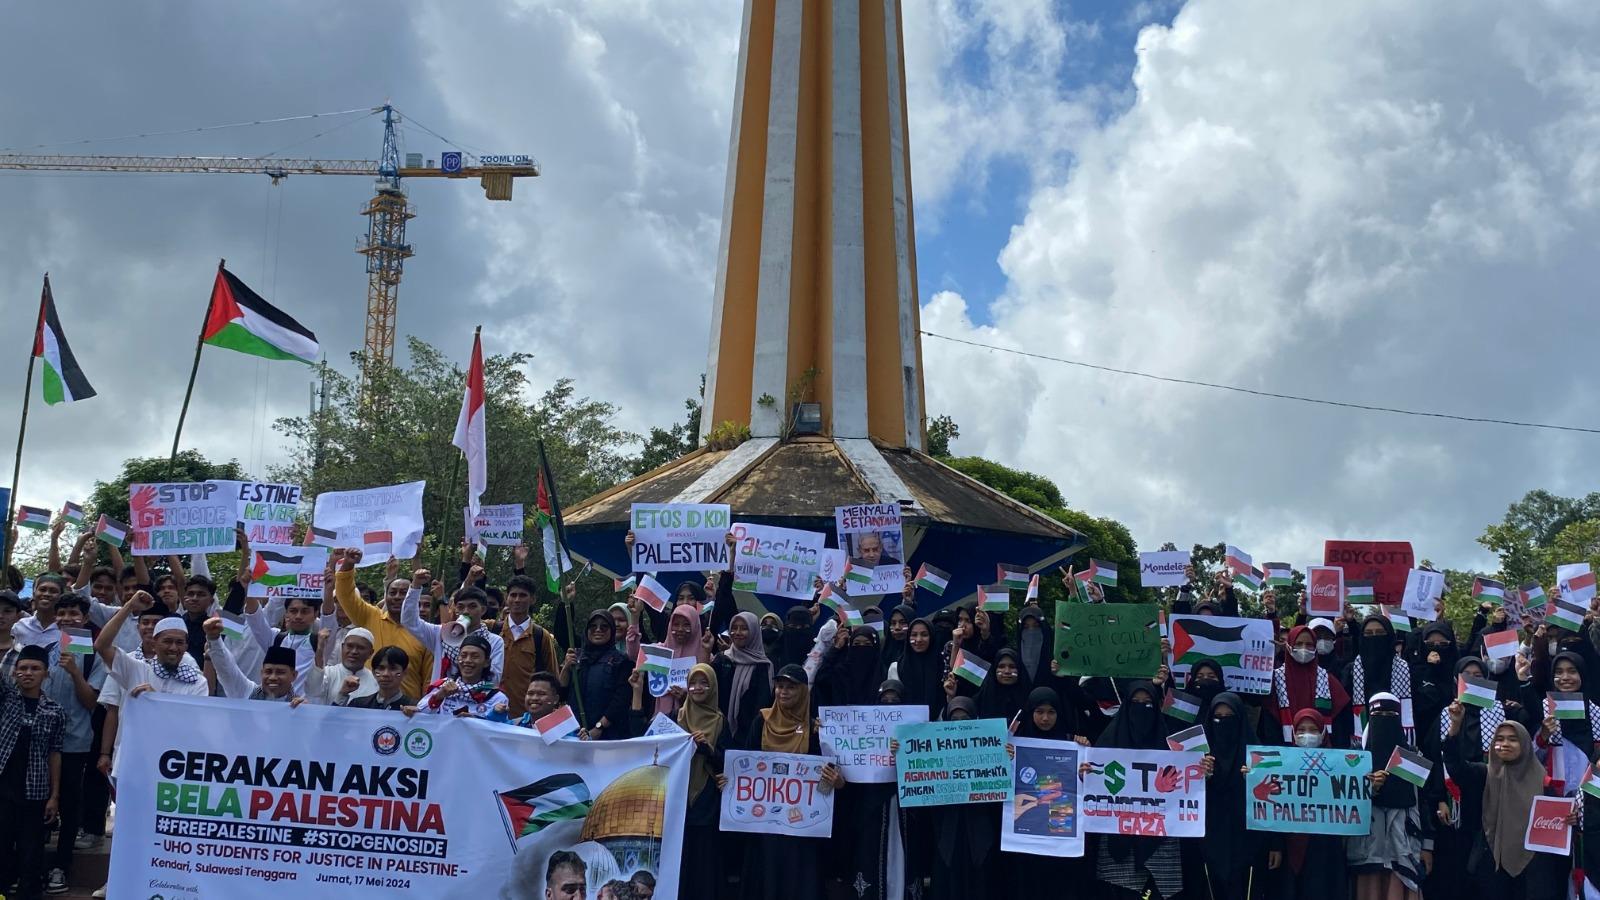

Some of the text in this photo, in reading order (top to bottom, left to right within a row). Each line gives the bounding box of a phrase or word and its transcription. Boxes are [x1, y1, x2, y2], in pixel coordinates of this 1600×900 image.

[480, 155, 529, 164] ZOOMLION
[159, 484, 218, 502] STOP
[238, 484, 299, 505] ESTINE
[138, 506, 228, 528] GENOCIDE
[244, 503, 296, 521] NEVER
[635, 509, 682, 529] ETOS
[704, 509, 728, 529] KDI
[842, 505, 894, 517] MENYALA
[134, 526, 235, 550] IN PALESTINA
[248, 524, 296, 545] ALONE
[635, 542, 728, 564] PALESTINA
[1329, 549, 1411, 565] BOYCOTT
[299, 574, 324, 588] FREE
[872, 583, 889, 593] YOU
[266, 586, 322, 597] PALESTINE
[1243, 654, 1272, 672] FREE
[824, 708, 903, 722] FROM THE RIVER
[825, 724, 886, 735] TO THE SEA
[905, 736, 1002, 755] JIKA KAMU TIDAK
[853, 753, 867, 766] BE
[869, 753, 896, 767] FREE
[908, 757, 943, 770] MAMPU
[158, 749, 429, 800] GERAKAN AKSI
[952, 764, 1008, 780] SETIDAKNYA
[736, 776, 820, 806] BOIKOT
[900, 785, 935, 800] JANGAN
[1270, 773, 1372, 800] STOP WAR
[156, 781, 447, 836] BELA PALESTINA
[1083, 794, 1199, 821] GENOCIDE IN
[1253, 801, 1362, 825] IN PALESTINA
[1119, 816, 1167, 837] GAZA
[157, 816, 445, 857] #FREEPALESTINE #STOPGENOSIDE
[164, 841, 192, 855] UHO
[196, 844, 269, 862] STUDENTS
[273, 850, 301, 864] FOR
[305, 852, 363, 869] JUSTICE
[367, 856, 382, 870] IN
[386, 859, 458, 877] PALESTINE
[151, 857, 411, 889] Kendari, Sulawesi Tenggara Jumat, 17 Mei 2024
